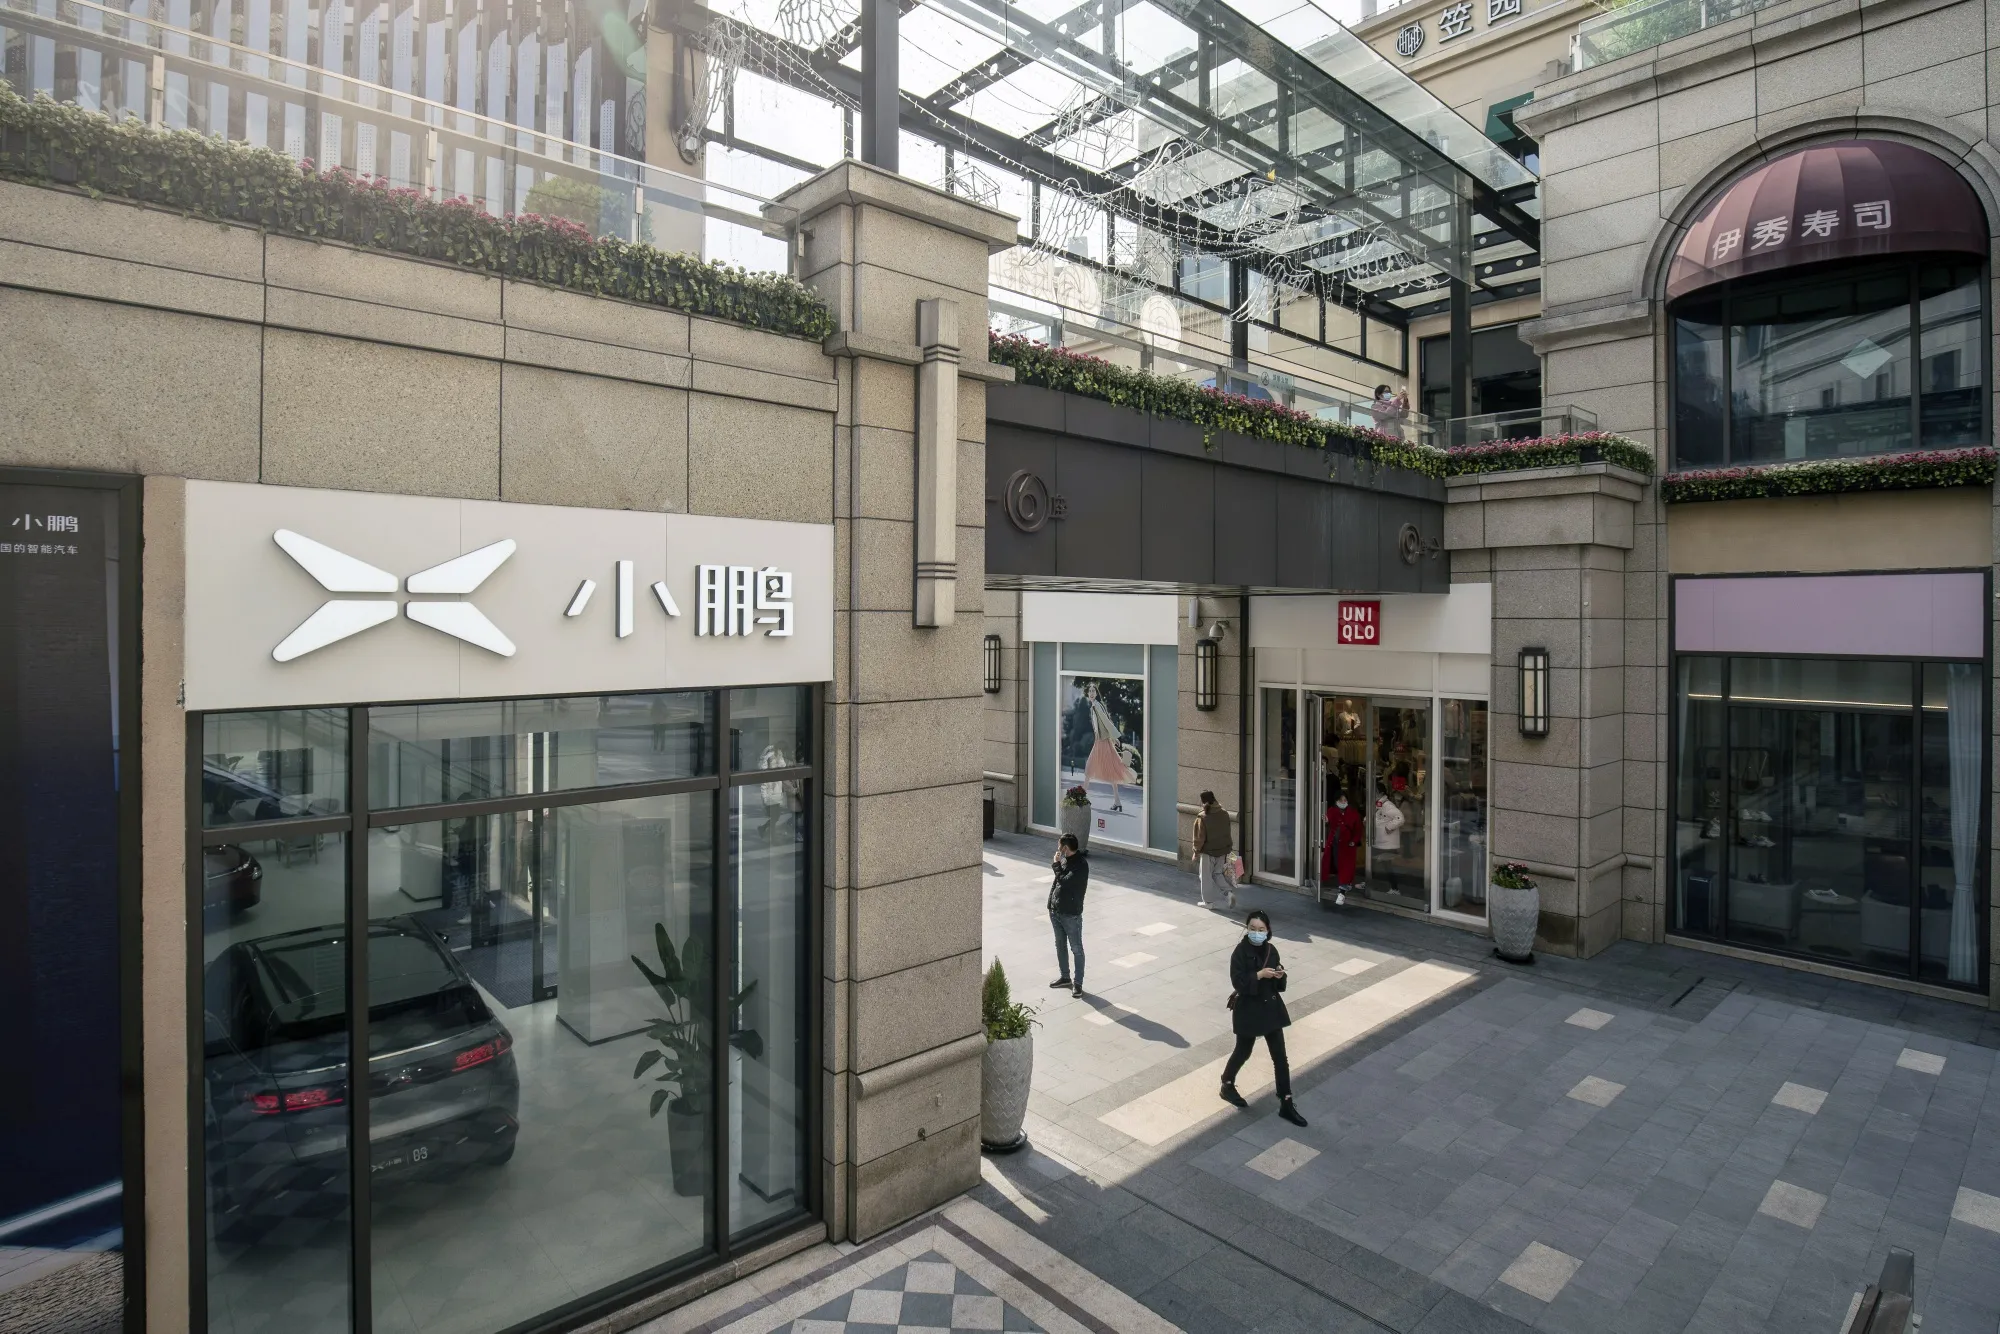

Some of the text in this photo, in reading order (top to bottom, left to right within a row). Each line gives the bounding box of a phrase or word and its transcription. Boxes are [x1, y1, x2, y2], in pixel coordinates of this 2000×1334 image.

[1712, 200, 1892, 260] 伊秀寿司
[12, 513, 79, 533] 小鹏
[0, 543, 79, 555] 国的智能汽车
[563, 560, 794, 638] 小鹏
[1342, 606, 1372, 622] UNI
[1342, 624, 1375, 642] QLO
